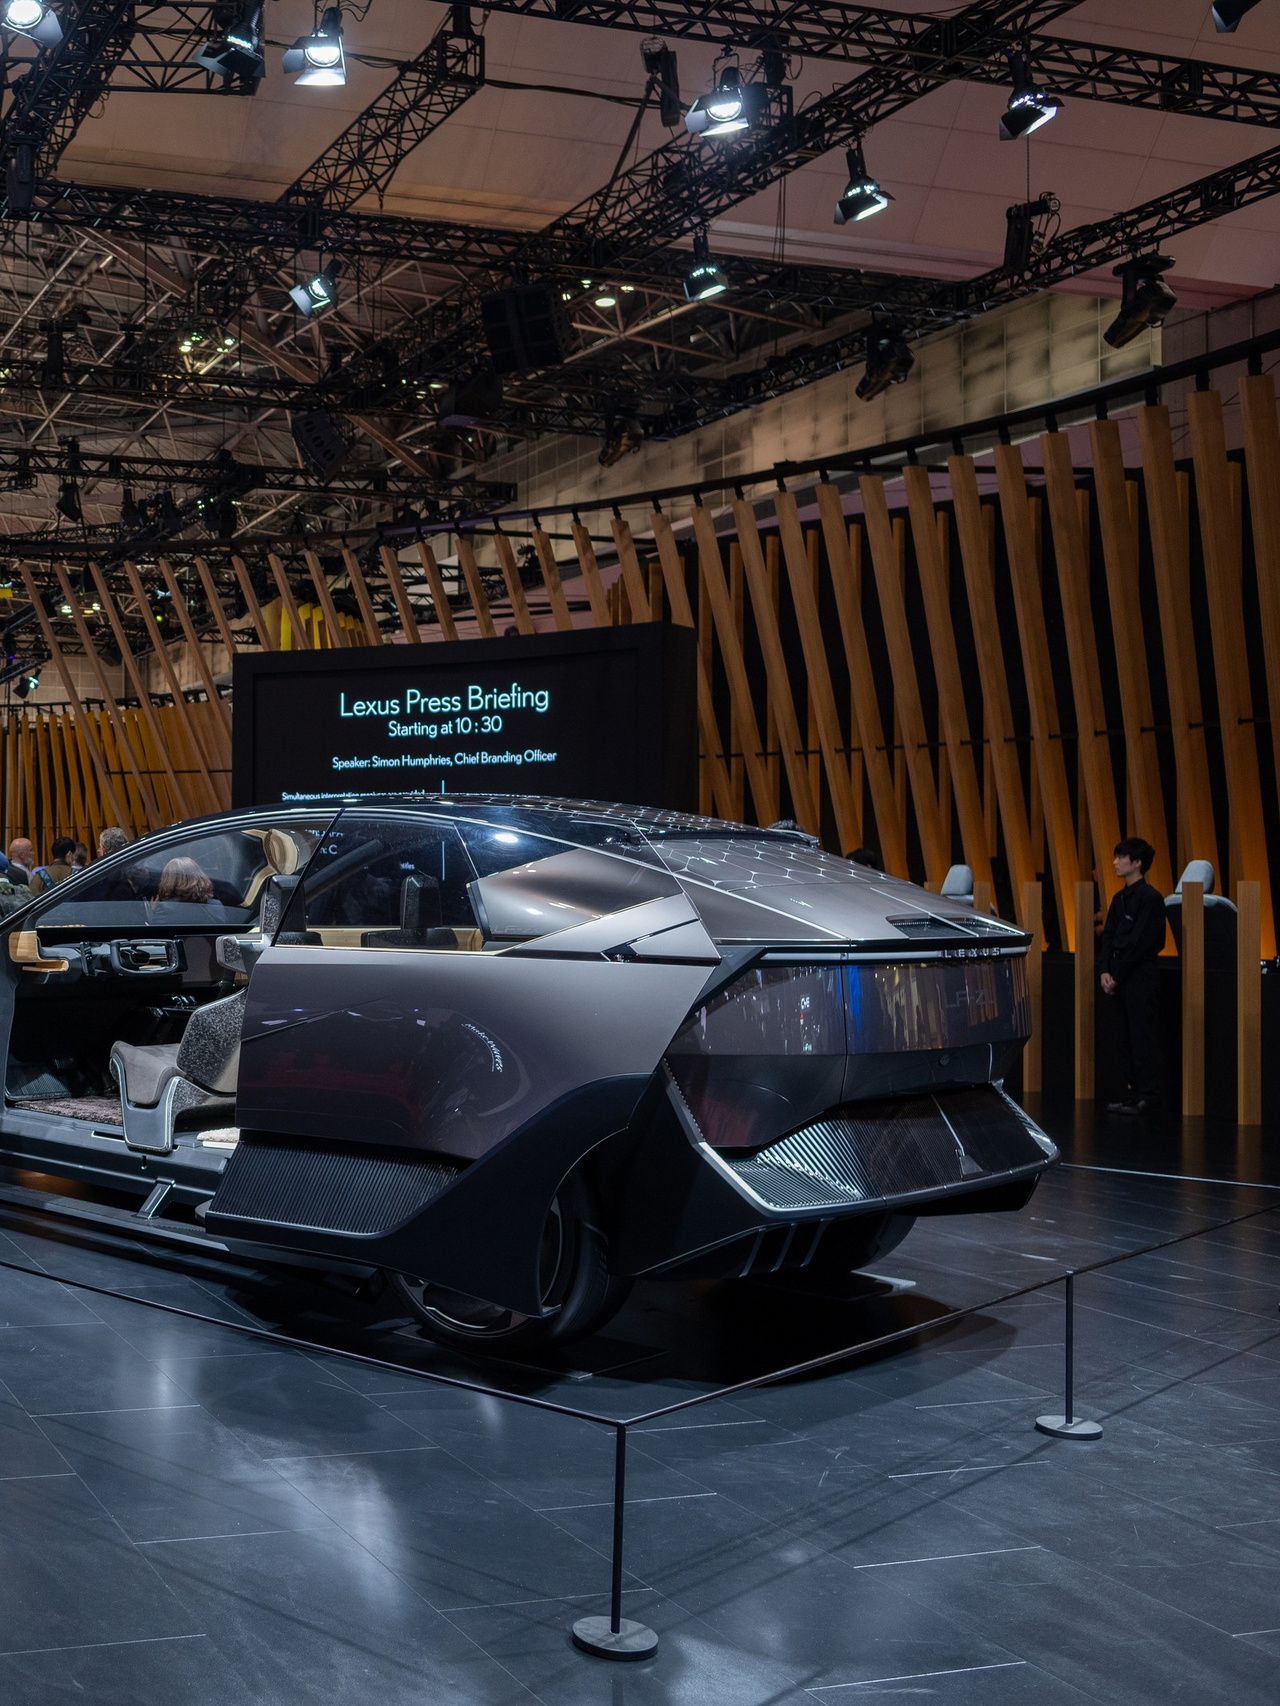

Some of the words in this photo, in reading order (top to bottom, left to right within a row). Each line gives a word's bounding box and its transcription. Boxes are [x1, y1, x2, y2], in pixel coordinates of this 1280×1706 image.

[340, 692, 400, 717] Lexus
[406, 688, 462, 714] Press
[468, 682, 549, 713] Briefing
[388, 720, 438, 739] Starting
[440, 720, 453, 734] at
[332, 756, 371, 770] Speaker:
[372, 755, 400, 768] Simon
[401, 753, 453, 768] Humphries,
[454, 752, 480, 765] Chief
[481, 750, 522, 766] Branding
[524, 749, 557, 762] Officer
[282, 791, 320, 801] Simultaneous
[944, 947, 1000, 958] LEXUS
